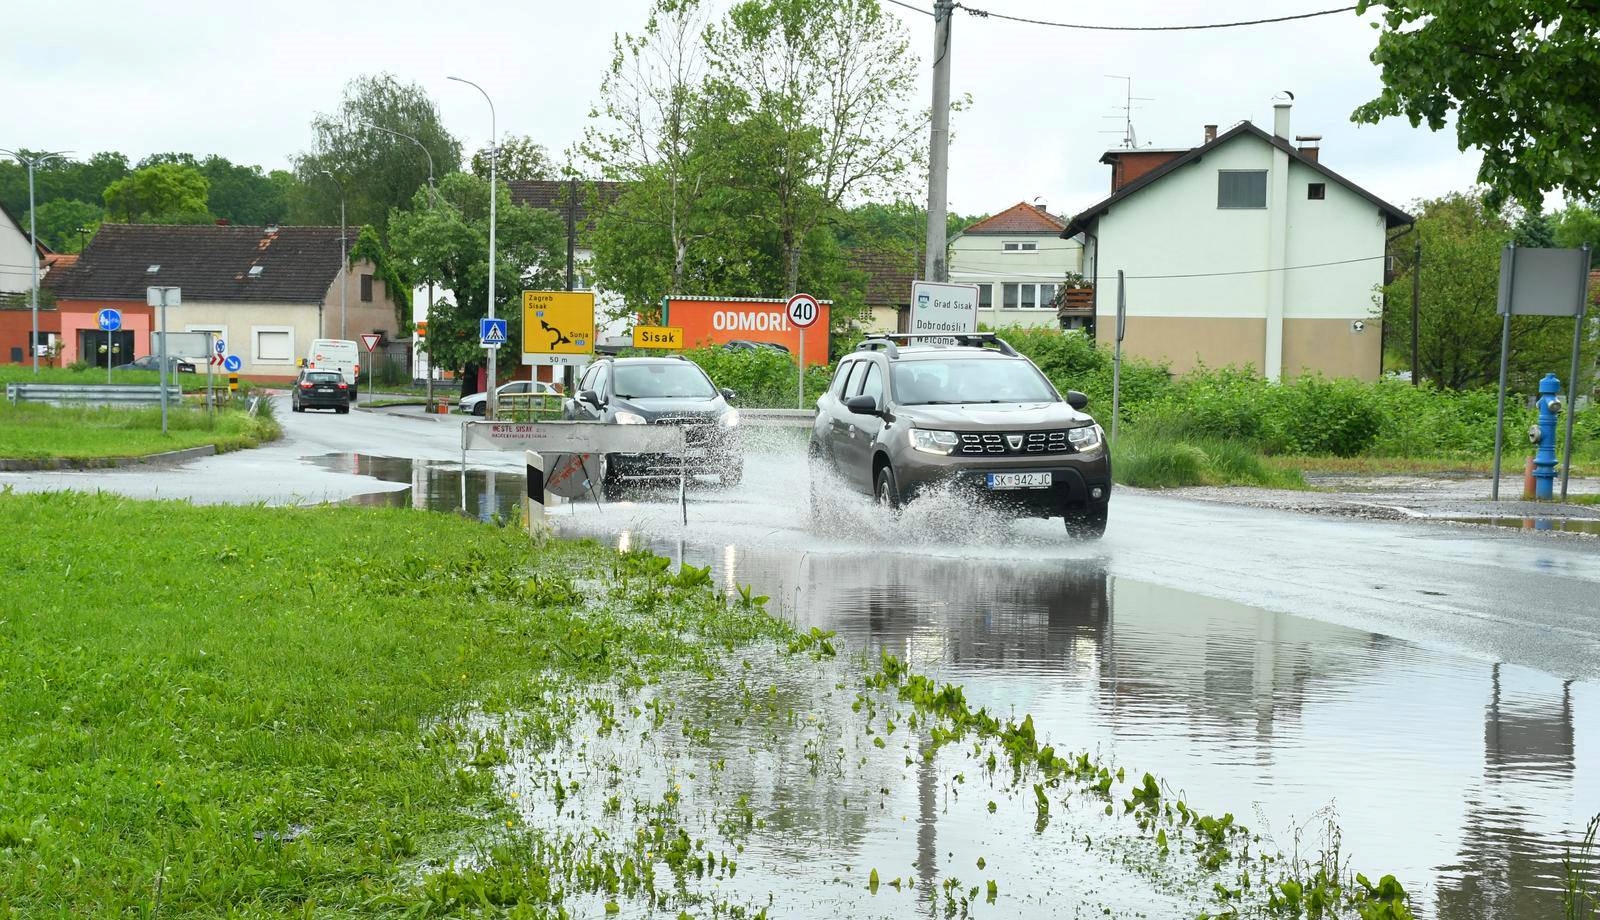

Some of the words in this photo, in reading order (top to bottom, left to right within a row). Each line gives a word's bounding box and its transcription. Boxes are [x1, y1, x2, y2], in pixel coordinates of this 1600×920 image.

[934, 299, 950, 308] Grad
[954, 300, 972, 310] Sisak
[793, 303, 812, 320] 40
[642, 331, 674, 342] Sisak
[995, 475, 1006, 485] SK
